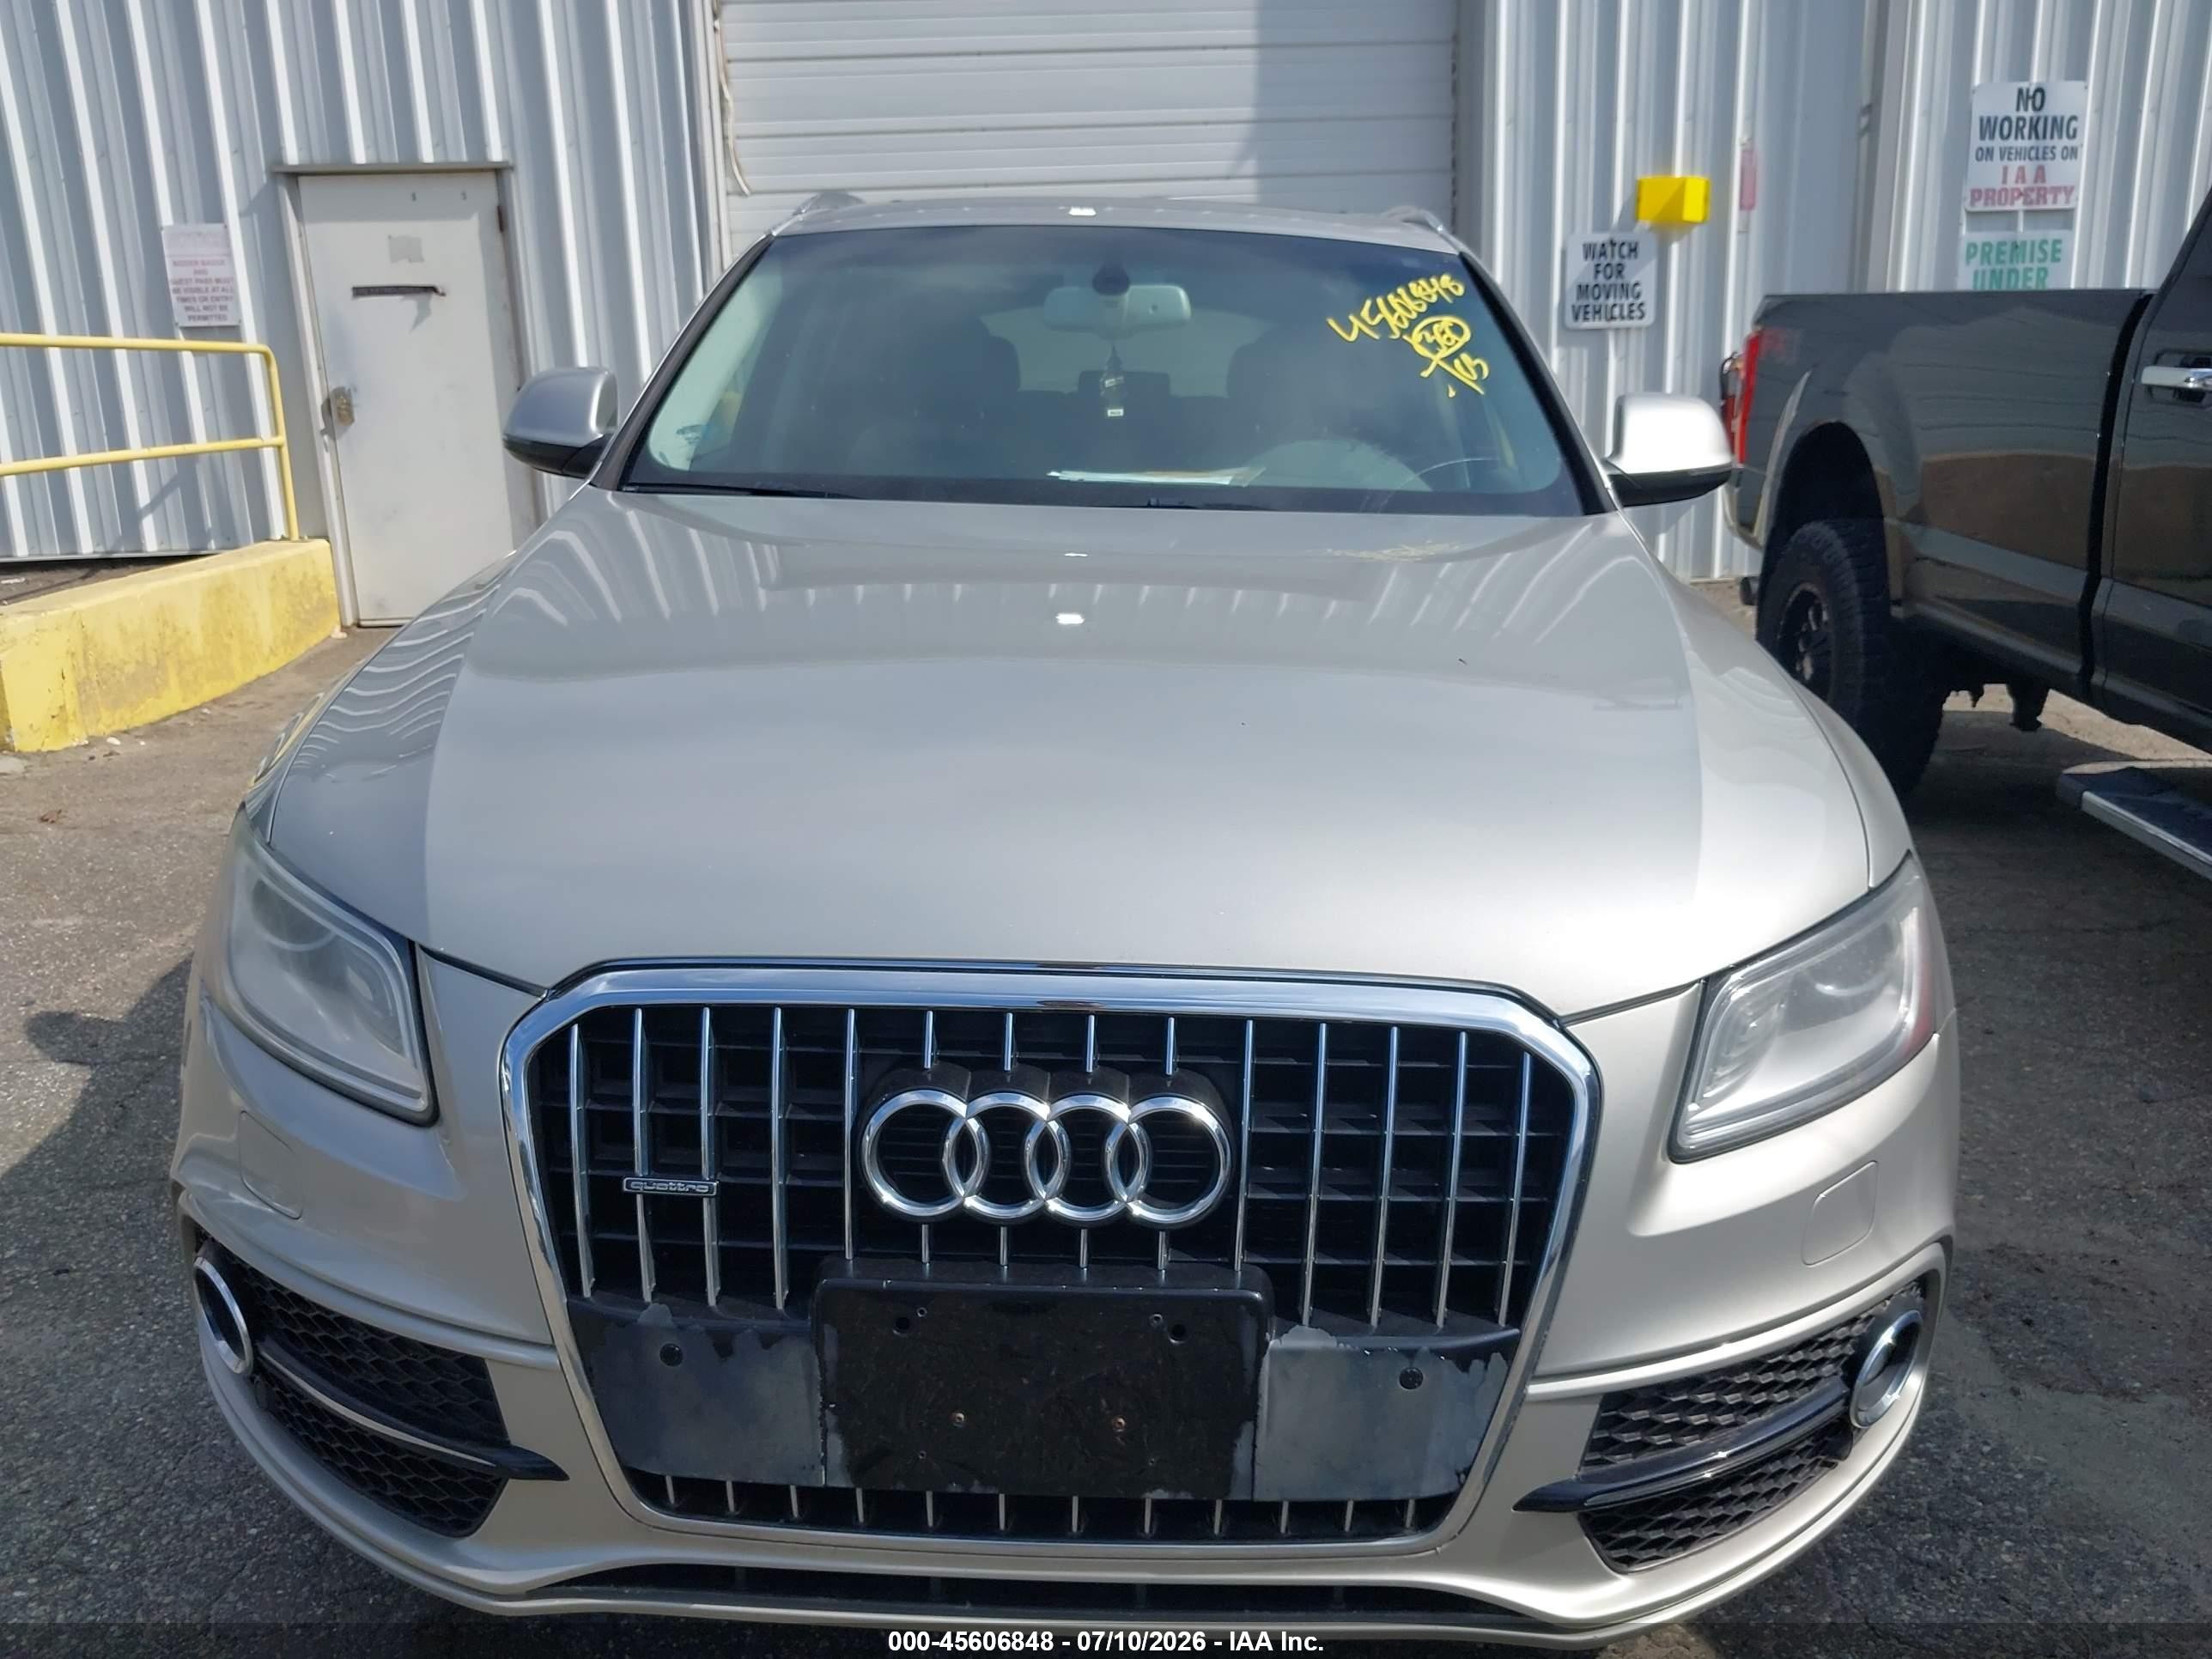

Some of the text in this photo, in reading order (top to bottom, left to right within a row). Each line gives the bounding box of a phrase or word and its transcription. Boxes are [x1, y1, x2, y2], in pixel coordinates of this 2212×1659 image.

[2016, 87, 2045, 112] NO
[1978, 115, 2078, 141] WORKING
[1975, 145, 2078, 161] ON VEHICLES ON
[1970, 185, 2075, 206] PROPERTY
[1583, 240, 1638, 261] WATCH
[1966, 239, 2063, 264] PREMISE
[1594, 263, 1625, 279] FOR
[1972, 266, 2048, 289] UNDER
[1577, 282, 1642, 301] MOVING
[1571, 302, 1645, 322] VEHICLES
[630, 1181, 709, 1193] quattro
